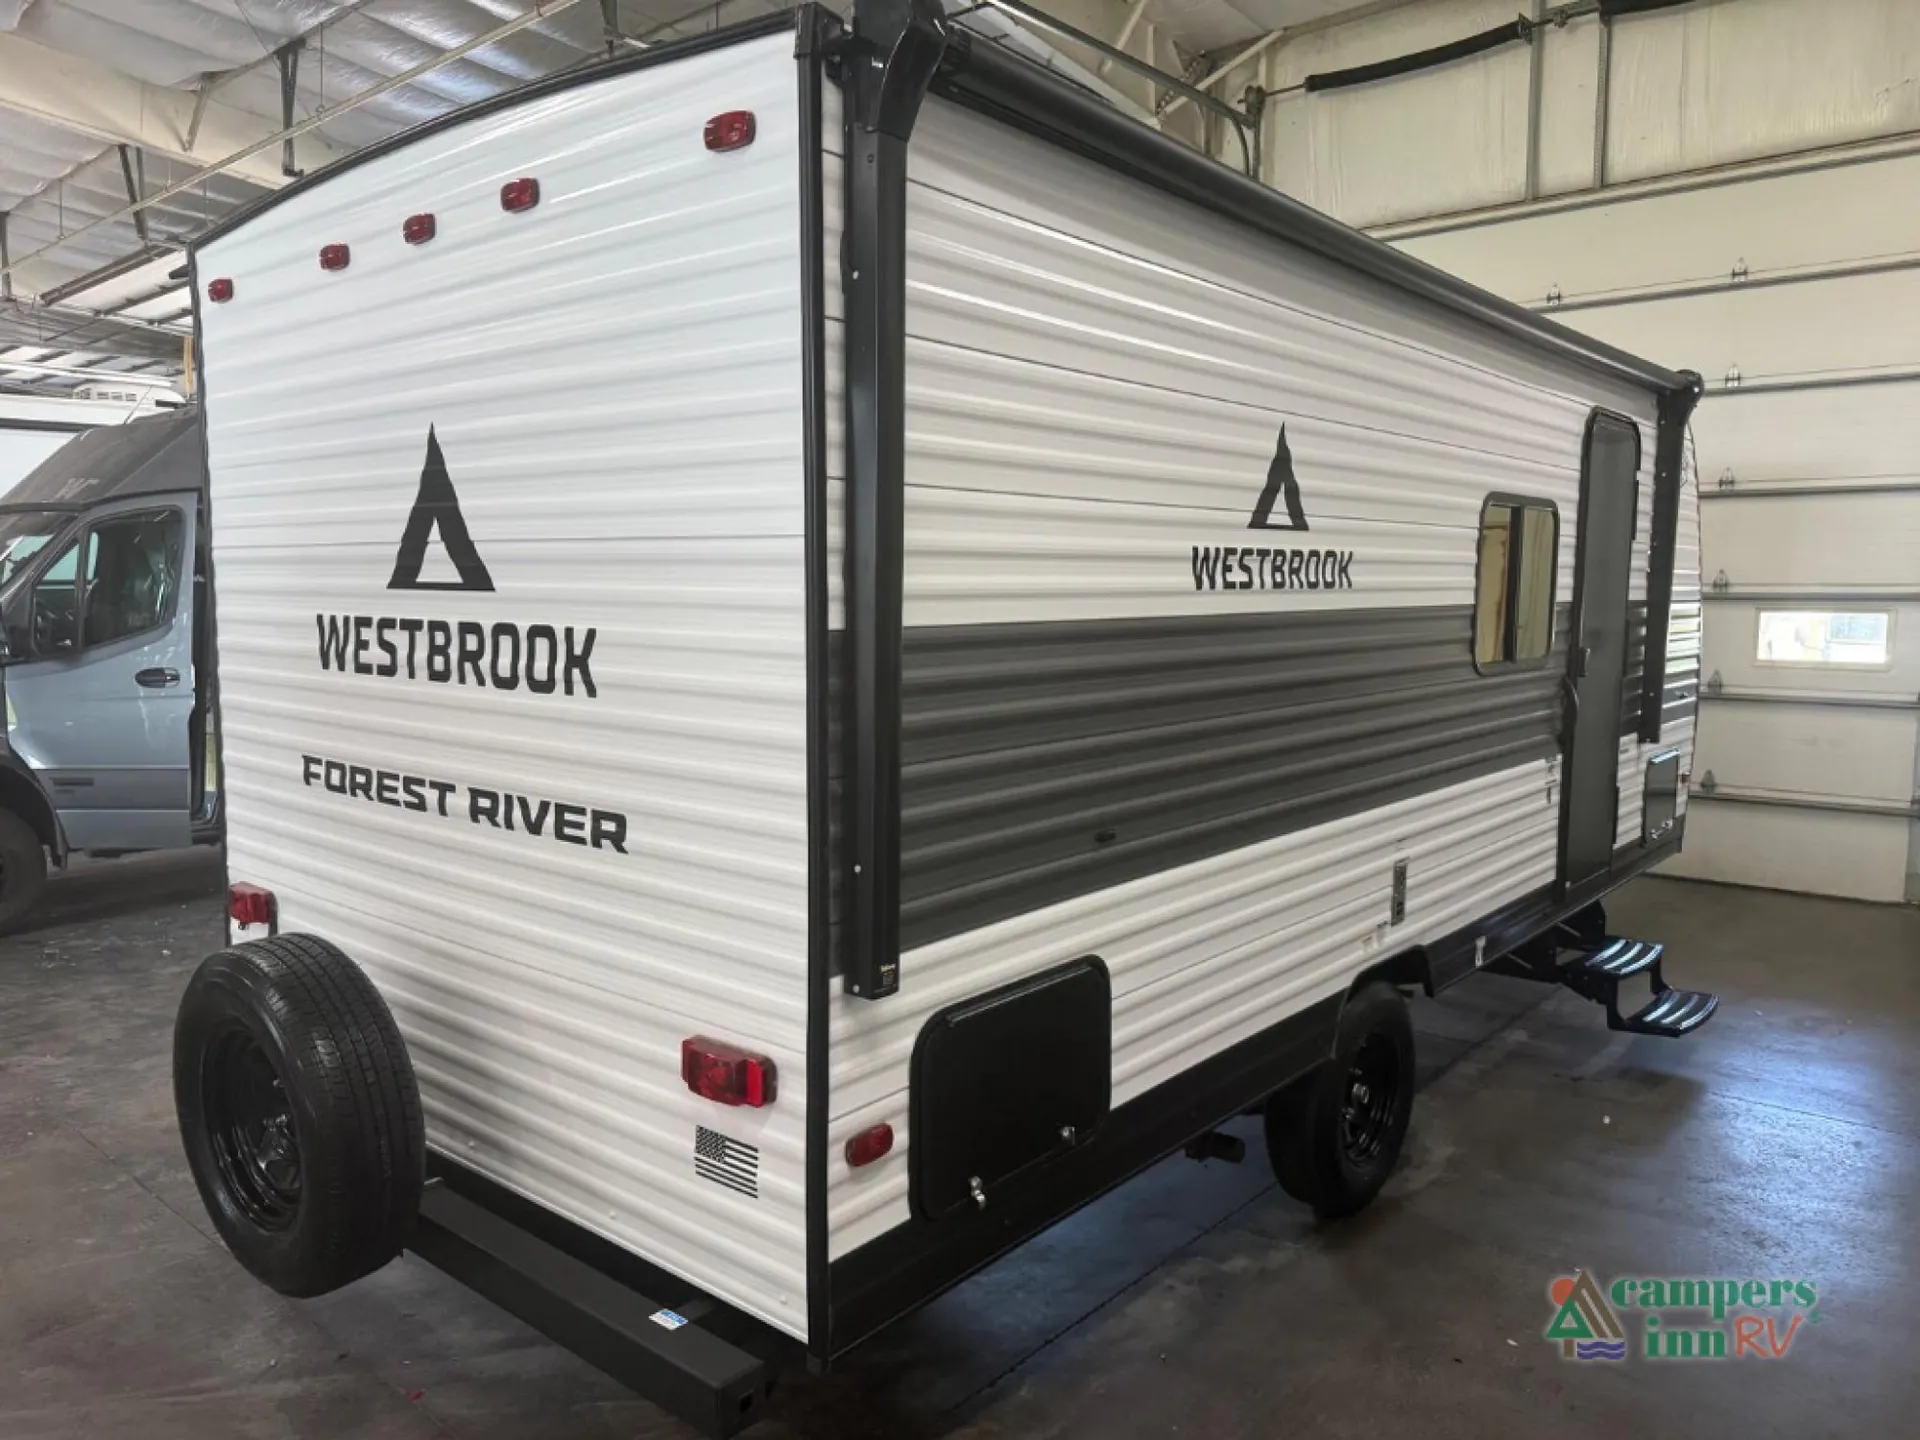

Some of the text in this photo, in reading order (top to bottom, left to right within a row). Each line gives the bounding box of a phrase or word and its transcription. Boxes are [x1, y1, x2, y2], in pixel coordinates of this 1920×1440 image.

[1191, 545, 1354, 591] WESTBROOK
[316, 613, 598, 698] WESTBROOK
[301, 755, 629, 854] FOREST RIVER
